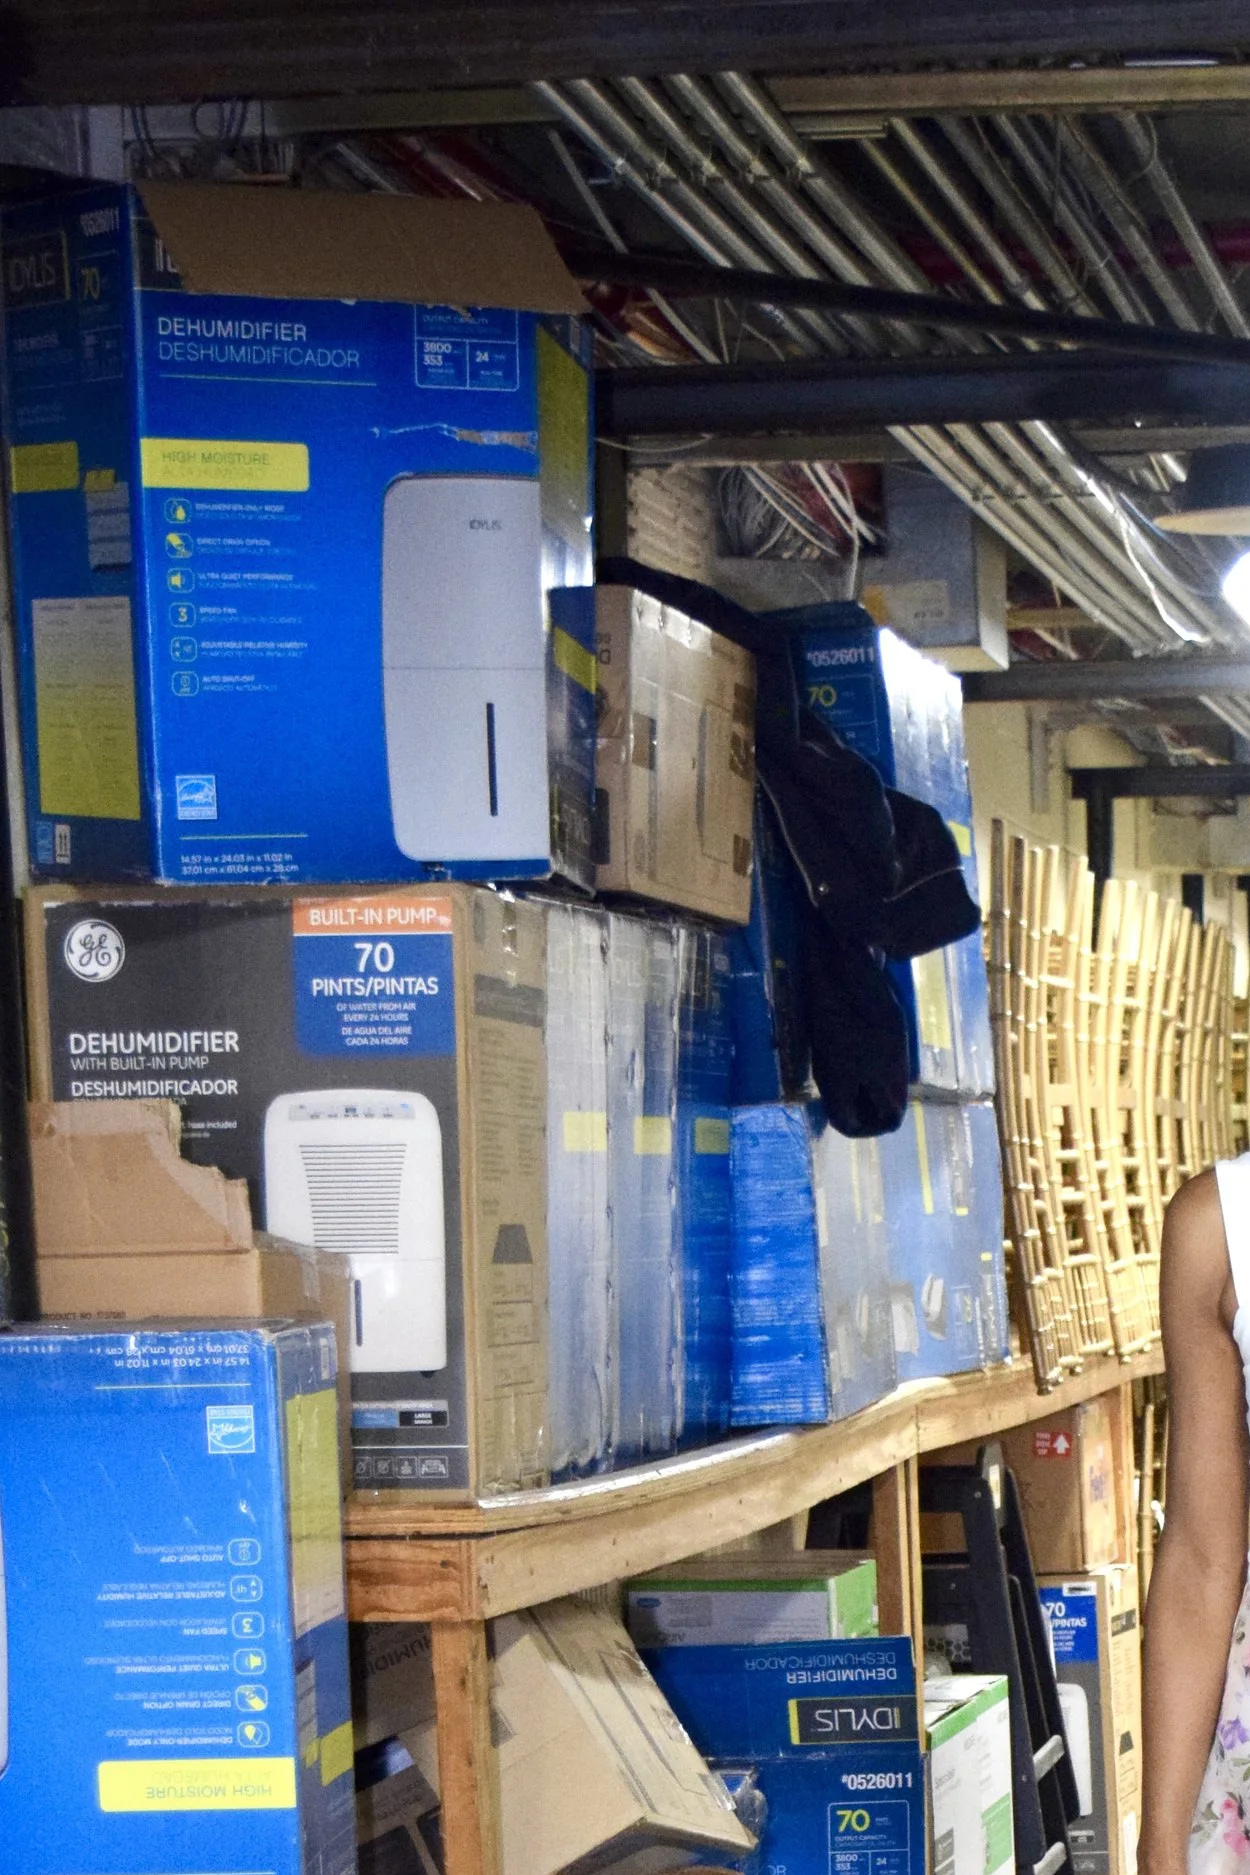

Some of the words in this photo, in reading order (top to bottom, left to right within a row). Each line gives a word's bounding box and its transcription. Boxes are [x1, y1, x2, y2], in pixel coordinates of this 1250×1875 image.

[157, 316, 307, 342] DEHUMIDIFIER
[423, 342, 452, 354] 3800
[158, 341, 360, 368] DESHUMIDIFICADOR
[475, 350, 489, 363] 24
[423, 354, 443, 366] 353
[162, 451, 196, 463] HIGH
[201, 451, 270, 466] MOISTURE
[807, 684, 838, 708] 70
[204, 855, 212, 863] in
[246, 854, 255, 862] in
[284, 853, 293, 861] in
[309, 907, 382, 926] BUILT-IN
[387, 907, 437, 925] PUMP
[354, 942, 395, 973] 70
[311, 976, 439, 997] PINTS/PINTAS
[336, 1003, 347, 1012] OF
[348, 1002, 377, 1011] WATER
[378, 1002, 402, 1011] FROM
[402, 1002, 416, 1011] AIR
[344, 1013, 367, 1022] EVERY
[369, 1013, 379, 1021] 24
[380, 1013, 409, 1021] HOURS
[341, 1027, 352, 1035] DE
[353, 1027, 377, 1035] AGUA
[378, 1026, 394, 1035] DEL
[394, 1026, 412, 1034] AIRE
[69, 1031, 240, 1055] DEHUMIDIFIER
[345, 1037, 368, 1046] CADA
[369, 1037, 380, 1045] 24
[380, 1037, 409, 1045] HORAS
[70, 1057, 107, 1071] WITH
[110, 1056, 166, 1070] BUILT-IN
[169, 1056, 209, 1070] PUMP
[71, 1079, 238, 1097] DESHUMIDIFICADOR
[206, 1120, 237, 1129] included
[150, 1346, 166, 1354] cm
[169, 1345, 195, 1355] 61.04
[207, 1344, 222, 1353] cm
[115, 1360, 124, 1368] in
[161, 1358, 170, 1367] in
[173, 1357, 200, 1367] 24.03
[213, 1357, 222, 1366] in
[226, 1356, 250, 1366] 14.57
[202, 1554, 223, 1562] AUTO
[96, 1592, 134, 1601] HUMIDITY
[136, 1592, 173, 1600] RELATIVE
[176, 1591, 226, 1599] ADJUSTABLE
[1045, 1601, 1066, 1618] 70
[242, 1618, 253, 1633] 3
[183, 1628, 200, 1636] FAN
[201, 1627, 228, 1635] SPEED
[744, 1651, 897, 1671] DESHUMIDIFICADOR
[115, 1664, 176, 1674] PERFORMANCE
[178, 1664, 202, 1672] QUIET
[203, 1663, 229, 1672] ULTRA
[786, 1668, 898, 1684] DEHUMIDIFIER
[143, 1701, 174, 1710] OPTION
[176, 1700, 201, 1709] DRAIN
[203, 1699, 232, 1708] DIRECT
[815, 1707, 901, 1732] IDYLIS
[127, 1737, 152, 1746] MODE
[841, 1772, 913, 1791] #0526011
[146, 1785, 227, 1799] MOISTURE
[232, 1784, 272, 1797] HIGH
[836, 1809, 871, 1833] 70
[835, 1854, 858, 1862] 3800
[875, 1857, 887, 1866] 24
[835, 1863, 851, 1871] 353
